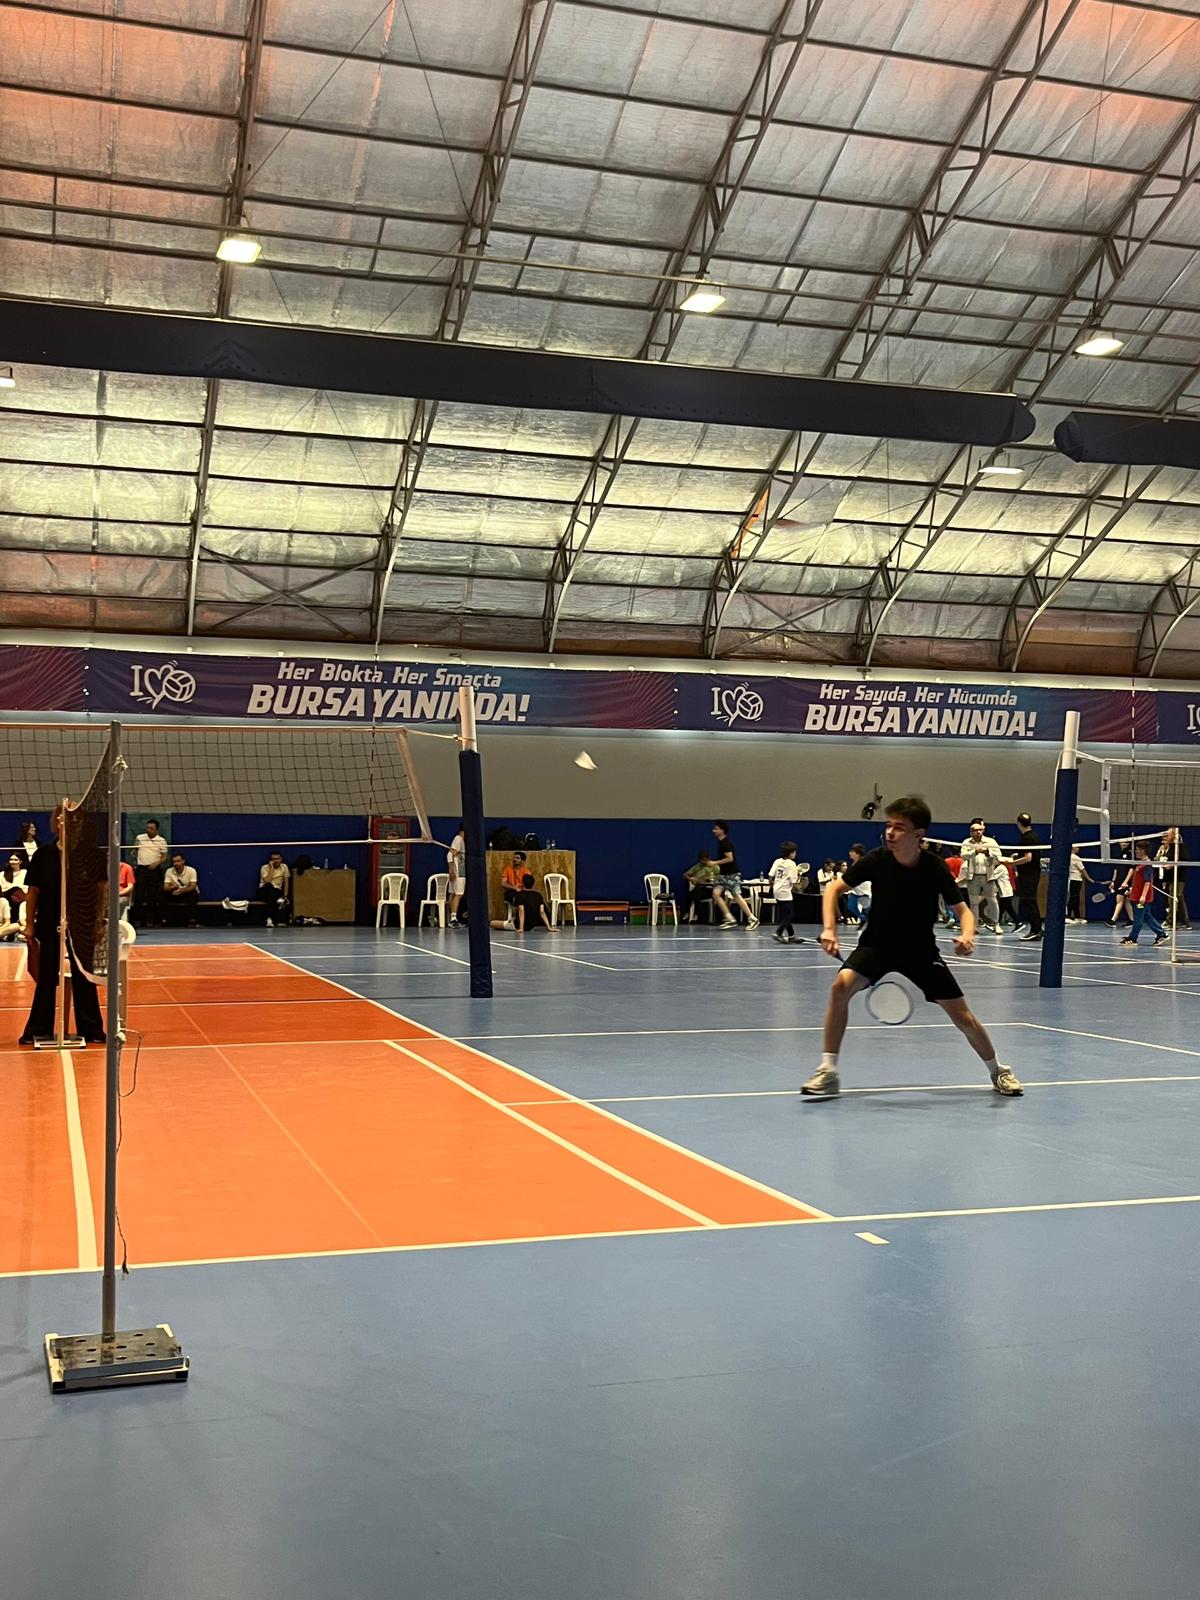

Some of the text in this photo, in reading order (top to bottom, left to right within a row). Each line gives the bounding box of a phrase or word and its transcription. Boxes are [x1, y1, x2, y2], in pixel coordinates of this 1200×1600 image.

[278, 662, 315, 680] Her
[392, 666, 428, 685] Her
[433, 668, 502, 690] Smaçta
[247, 684, 365, 717] BURSA
[819, 683, 849, 700] Her
[914, 687, 944, 703] Her
[948, 687, 1018, 706] Hücumda
[804, 704, 1037, 737] BURSA YANINDA!
